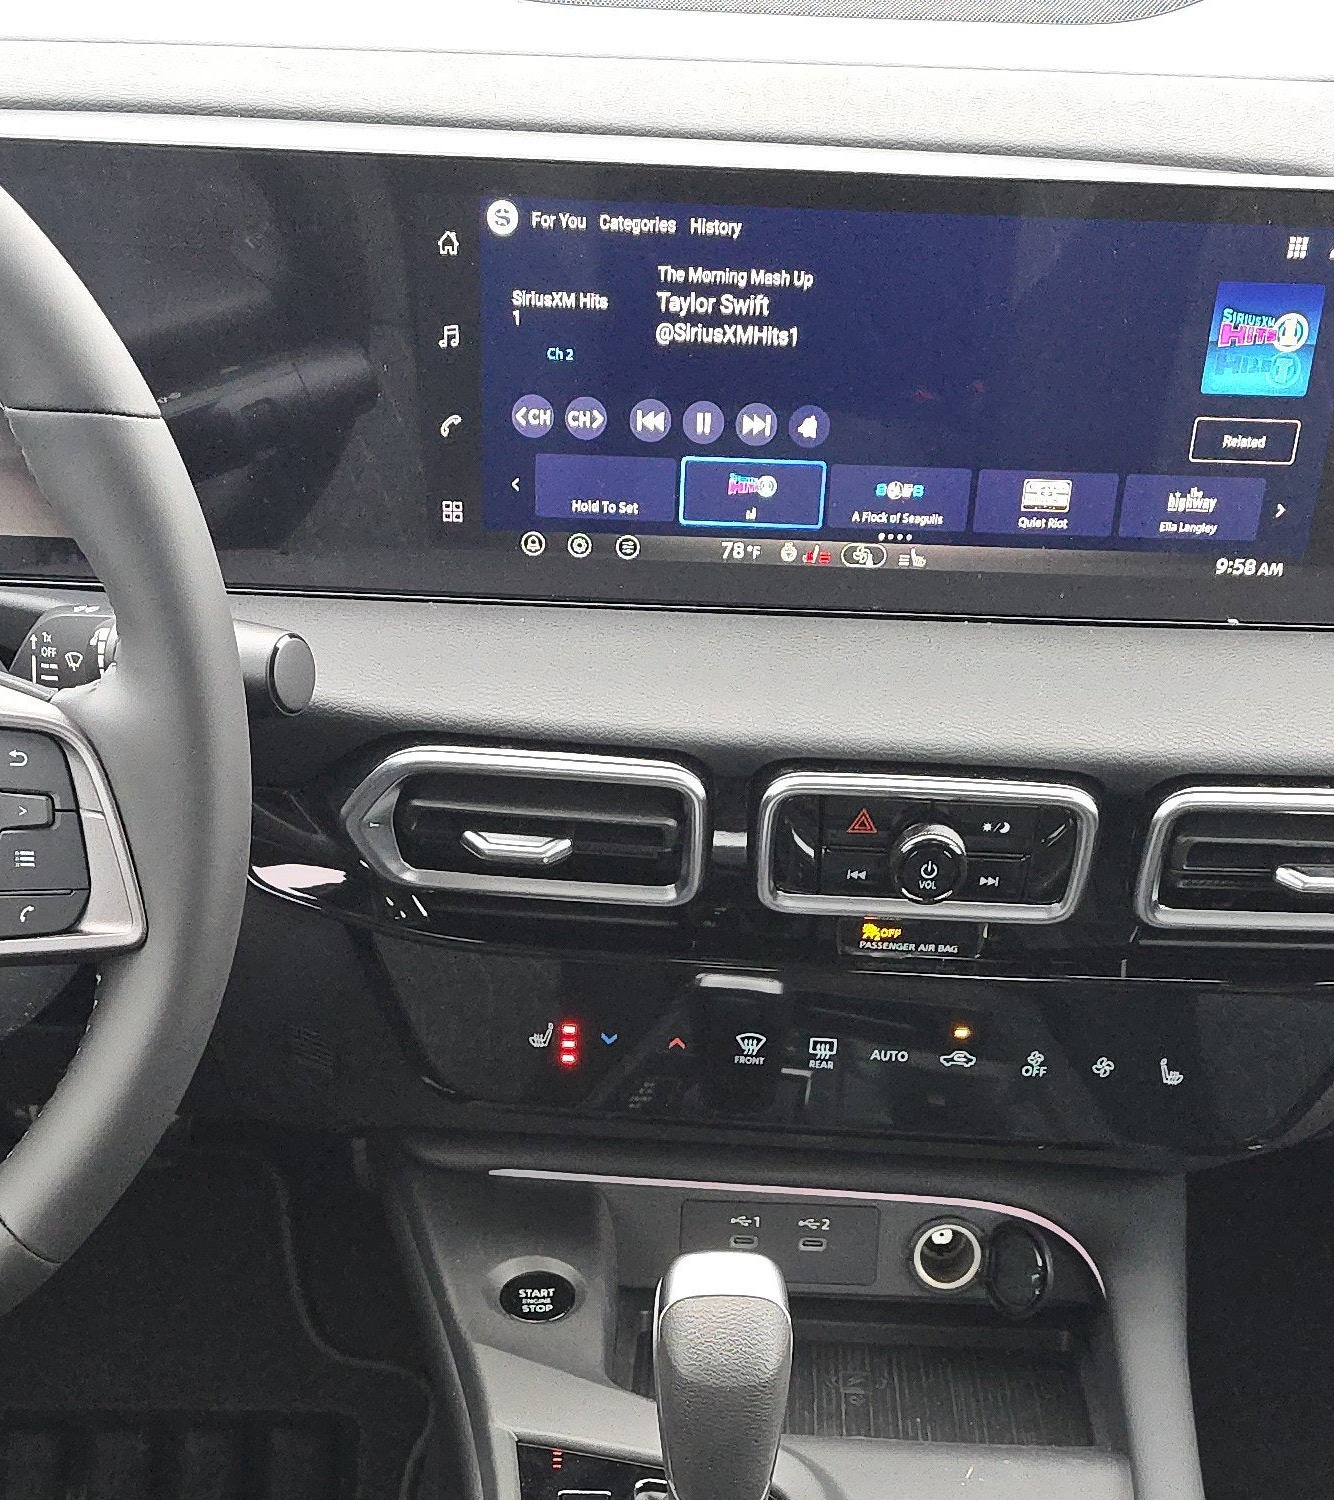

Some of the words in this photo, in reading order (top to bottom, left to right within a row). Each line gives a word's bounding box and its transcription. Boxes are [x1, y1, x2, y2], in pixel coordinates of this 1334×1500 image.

[531, 211, 557, 229] For
[558, 212, 586, 230] You
[599, 213, 677, 235] Categories
[690, 217, 742, 240] History
[658, 265, 685, 283] The
[688, 266, 748, 290] Morning
[750, 268, 791, 287] Mash
[793, 270, 814, 291] Up
[512, 289, 575, 309] SiriusXM
[579, 292, 609, 310] Hits
[656, 291, 717, 318] Taylor
[720, 292, 770, 317] Swift
[512, 309, 521, 327] 1
[655, 322, 798, 347] @SiriusXMHits1
[546, 347, 564, 360] Ch
[565, 348, 574, 361] 2
[1222, 434, 1267, 449] Related
[571, 499, 600, 513] Hold
[602, 500, 617, 514] To
[618, 501, 639, 516] Set
[851, 511, 860, 523] A
[862, 511, 887, 524] Flock
[889, 511, 900, 524] of
[902, 512, 944, 527] Seagulls
[1017, 516, 1046, 530] Quiet
[1047, 517, 1069, 530] Riot
[1159, 521, 1177, 533] Ella
[721, 541, 745, 560] 78
[1215, 557, 1257, 576] 9:58
[1256, 562, 1284, 577] AM
[40, 646, 58, 658] OFF
[918, 879, 937, 890] VOL
[880, 927, 902, 939] OFF
[859, 940, 916, 952] PASSENGER
[917, 943, 936, 953] AIR
[937, 944, 959, 954] BAG
[734, 1055, 766, 1066] FRONT
[870, 1049, 909, 1063] AUTO
[808, 1059, 834, 1070] REAR
[1021, 1065, 1048, 1078] OFF
[753, 1215, 761, 1228] 1
[820, 1218, 831, 1231] 2
[518, 1287, 555, 1299] START
[521, 1303, 554, 1314] STOP
